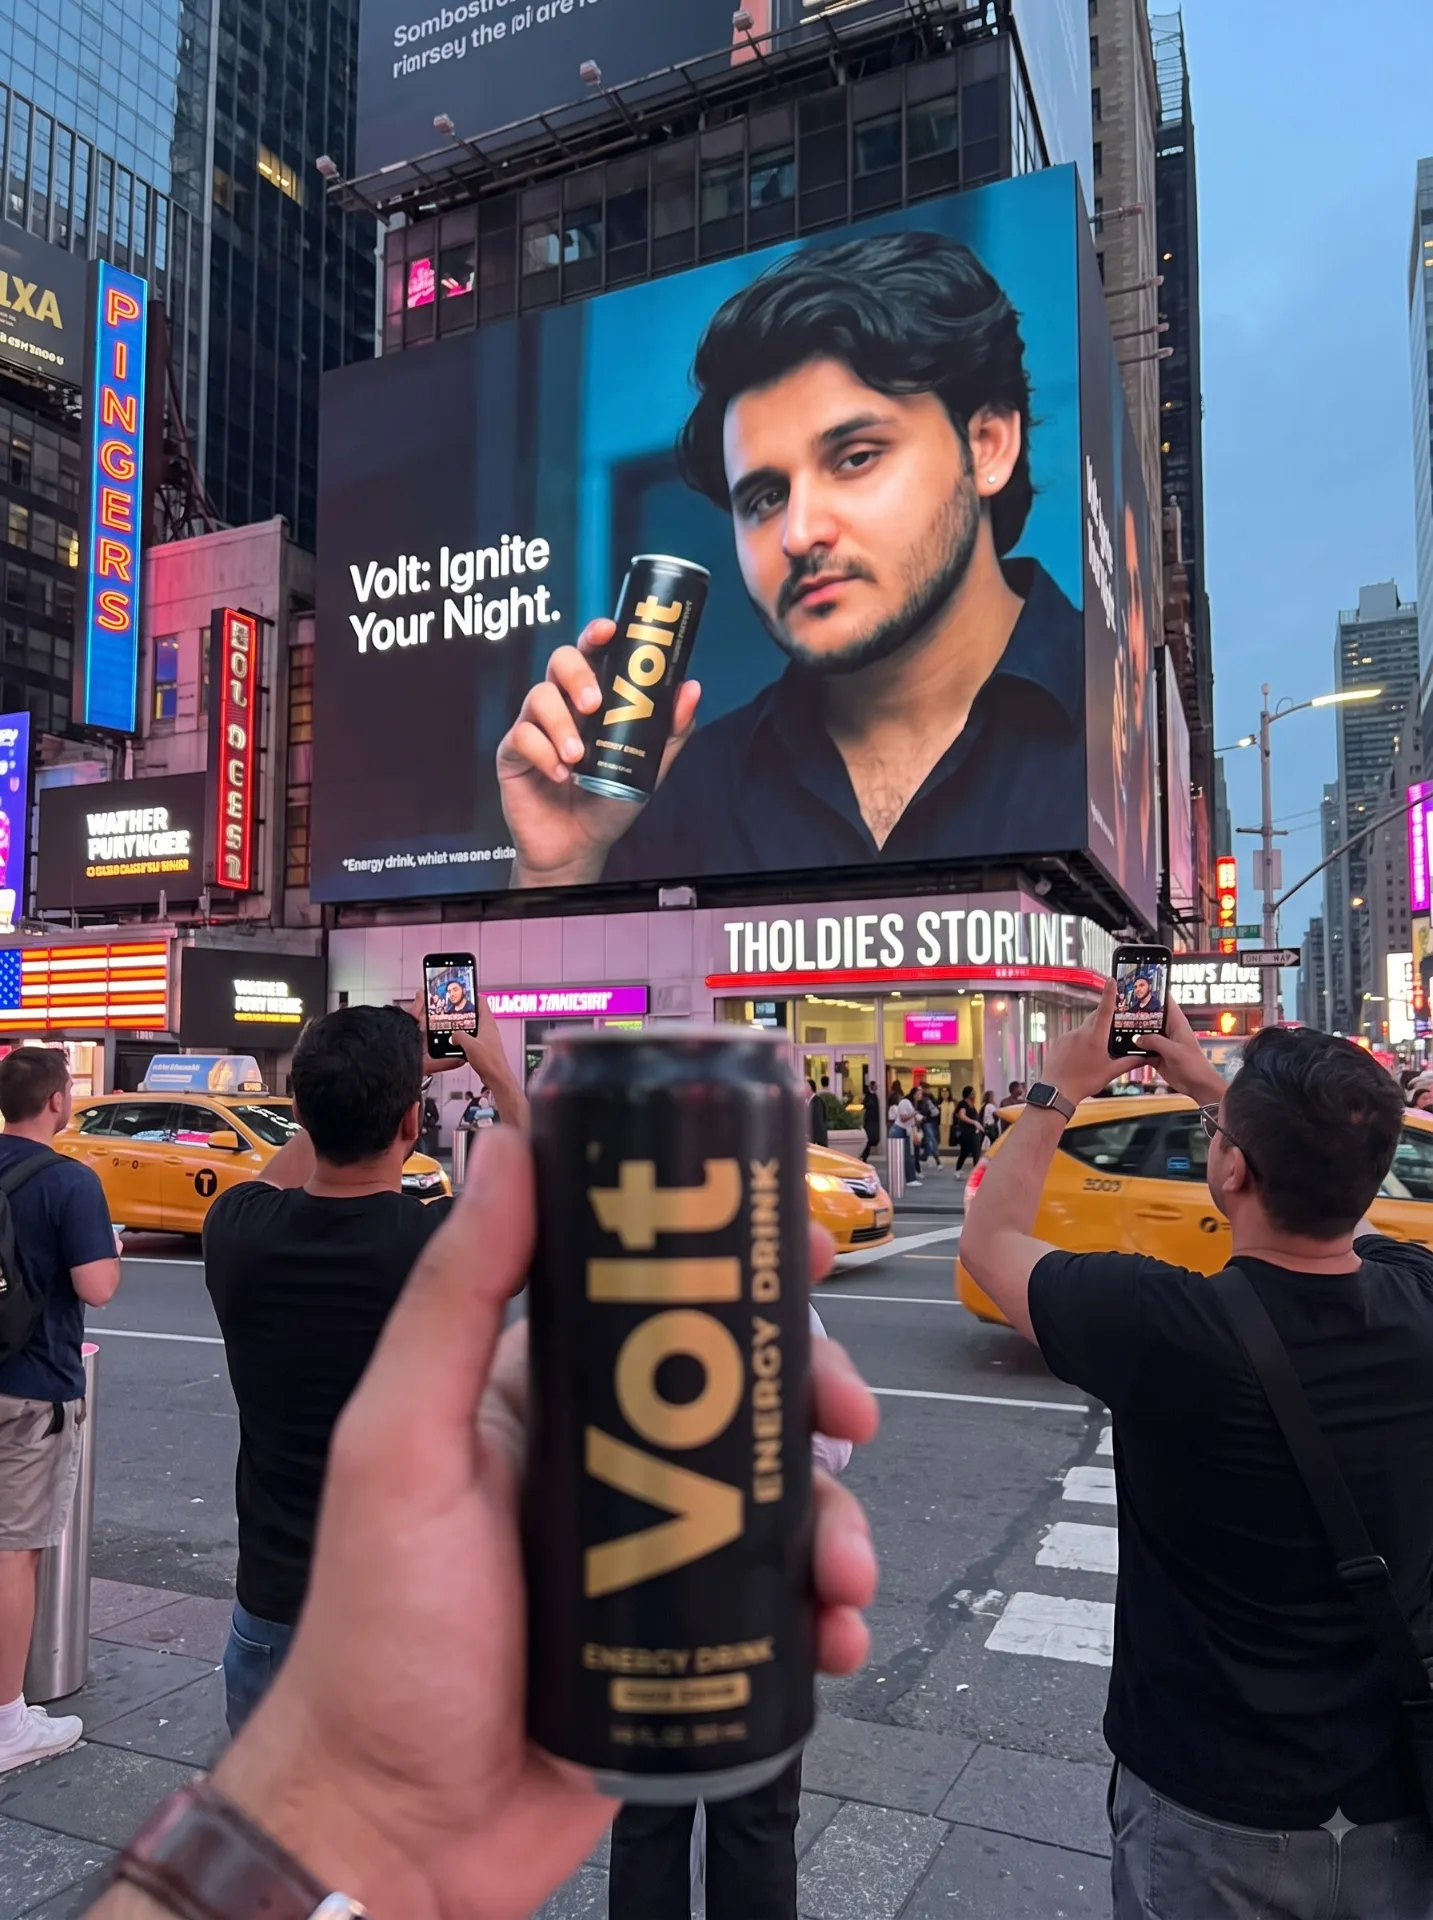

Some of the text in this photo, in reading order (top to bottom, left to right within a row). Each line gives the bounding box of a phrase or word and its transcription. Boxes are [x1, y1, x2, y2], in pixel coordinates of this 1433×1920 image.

[471, 22, 506, 48] the
[536, 0, 574, 23] are
[97, 288, 140, 632] PINGERS
[350, 533, 550, 602] Volt: Ignite
[349, 584, 561, 653] Your Night.
[449, 851, 469, 863] was
[724, 913, 904, 972] THOLDIES
[1245, 952, 1291, 962] ONE WAY
[751, 1157, 780, 1302] DRINK
